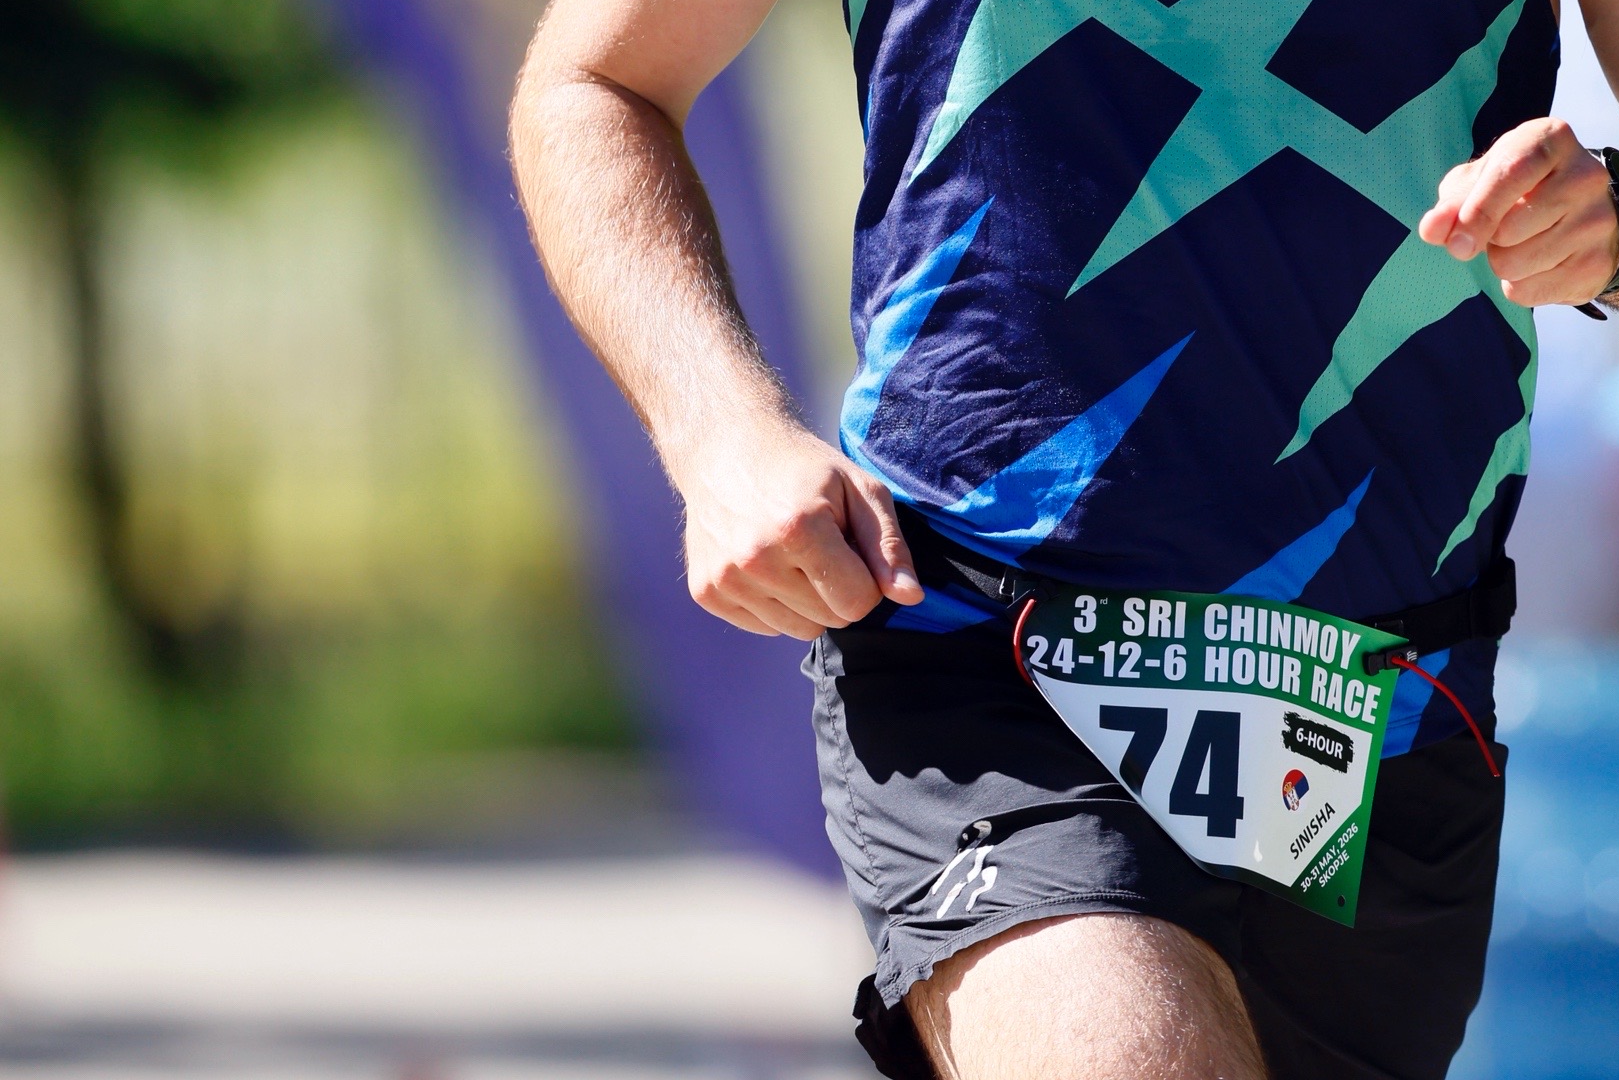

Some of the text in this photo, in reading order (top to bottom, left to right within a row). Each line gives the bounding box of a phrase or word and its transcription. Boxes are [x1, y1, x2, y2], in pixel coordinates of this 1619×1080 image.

[1122, 597, 1187, 639] SRI
[1203, 603, 1361, 670] CHINMOY
[1026, 634, 1382, 724] 24-12-6 HOUR RACE
[1099, 704, 1245, 839] 74
[1295, 727, 1344, 759] 6-HOUR
[1289, 802, 1336, 860] SINISHA
[1300, 822, 1359, 893] 30-31 MAY, 2026
[1318, 849, 1350, 888] SKOPJE
